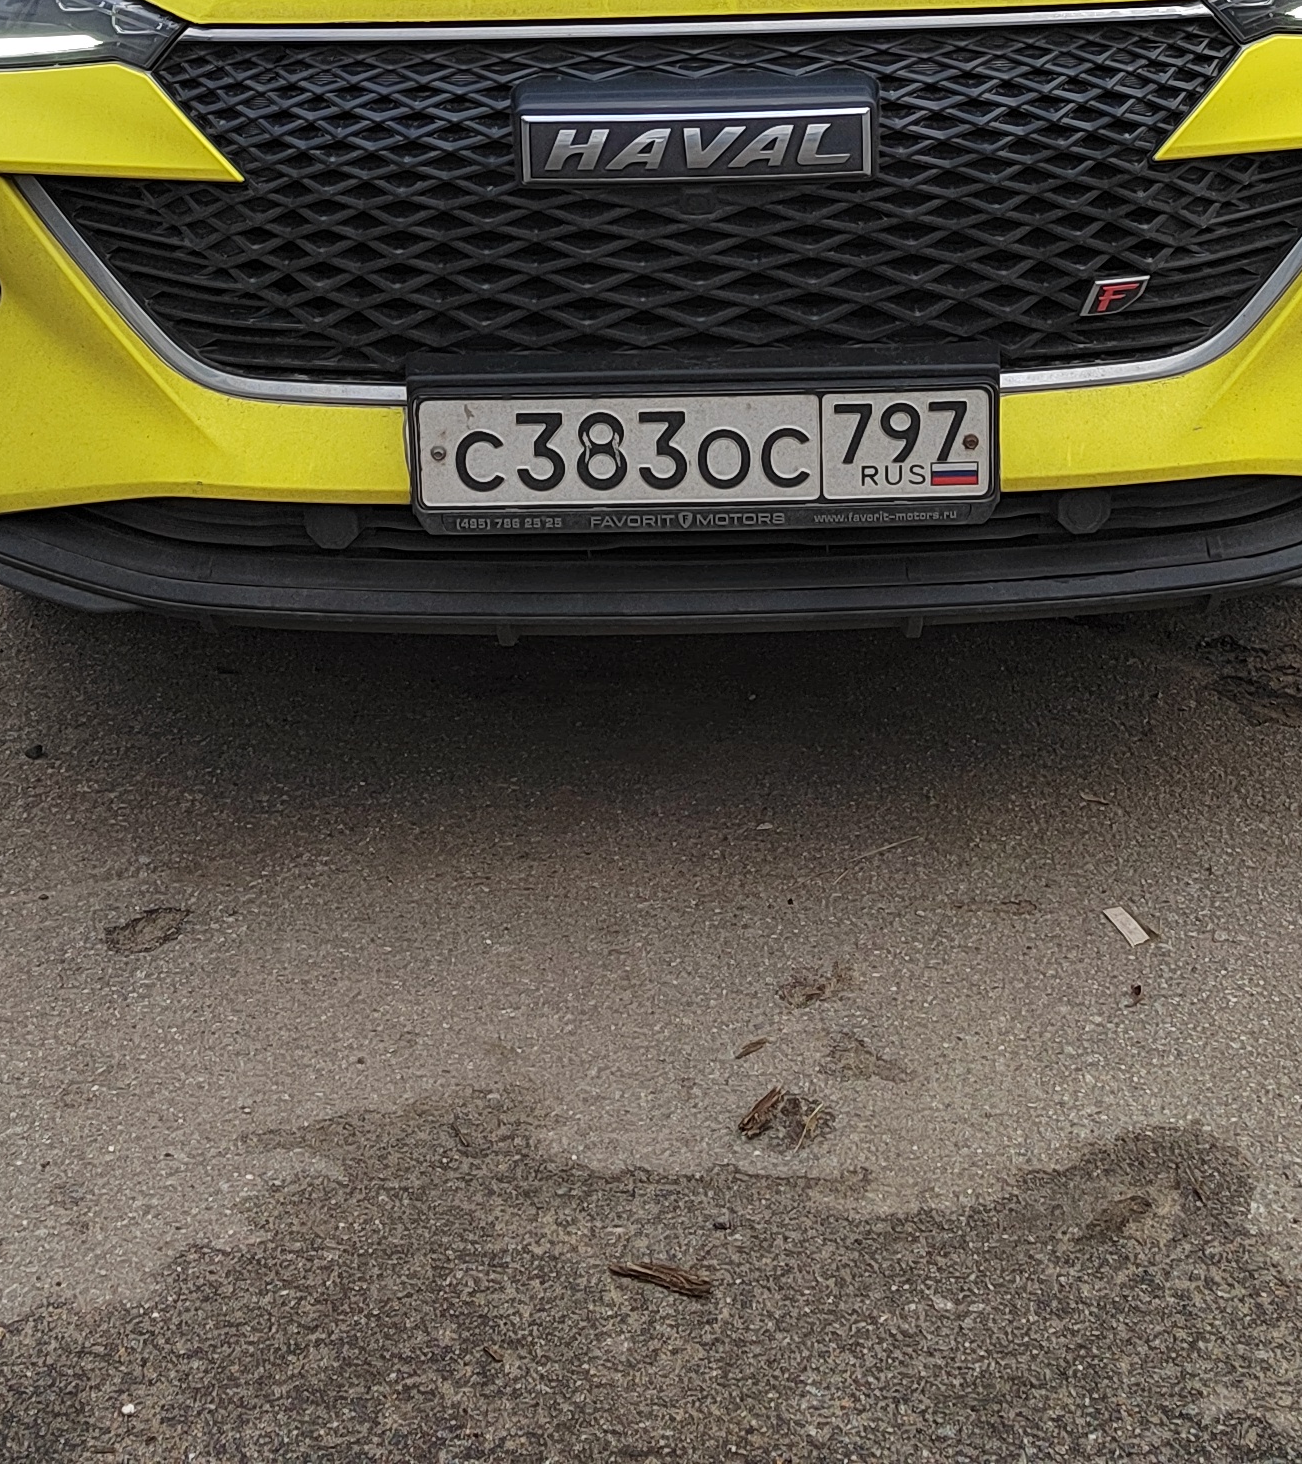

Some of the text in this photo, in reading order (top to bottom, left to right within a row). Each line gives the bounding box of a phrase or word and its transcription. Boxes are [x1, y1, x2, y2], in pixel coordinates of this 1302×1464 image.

[544, 122, 853, 171] HAVAL
[1096, 282, 1141, 312] F
[833, 399, 970, 465] 797
[861, 464, 926, 487] RUS
[524, 517, 541, 529] 25
[545, 517, 562, 529] 25
[590, 514, 675, 528] FAVORIT
[697, 512, 786, 526] MOTORS
[814, 510, 957, 523] www.favorit-motors.ru
